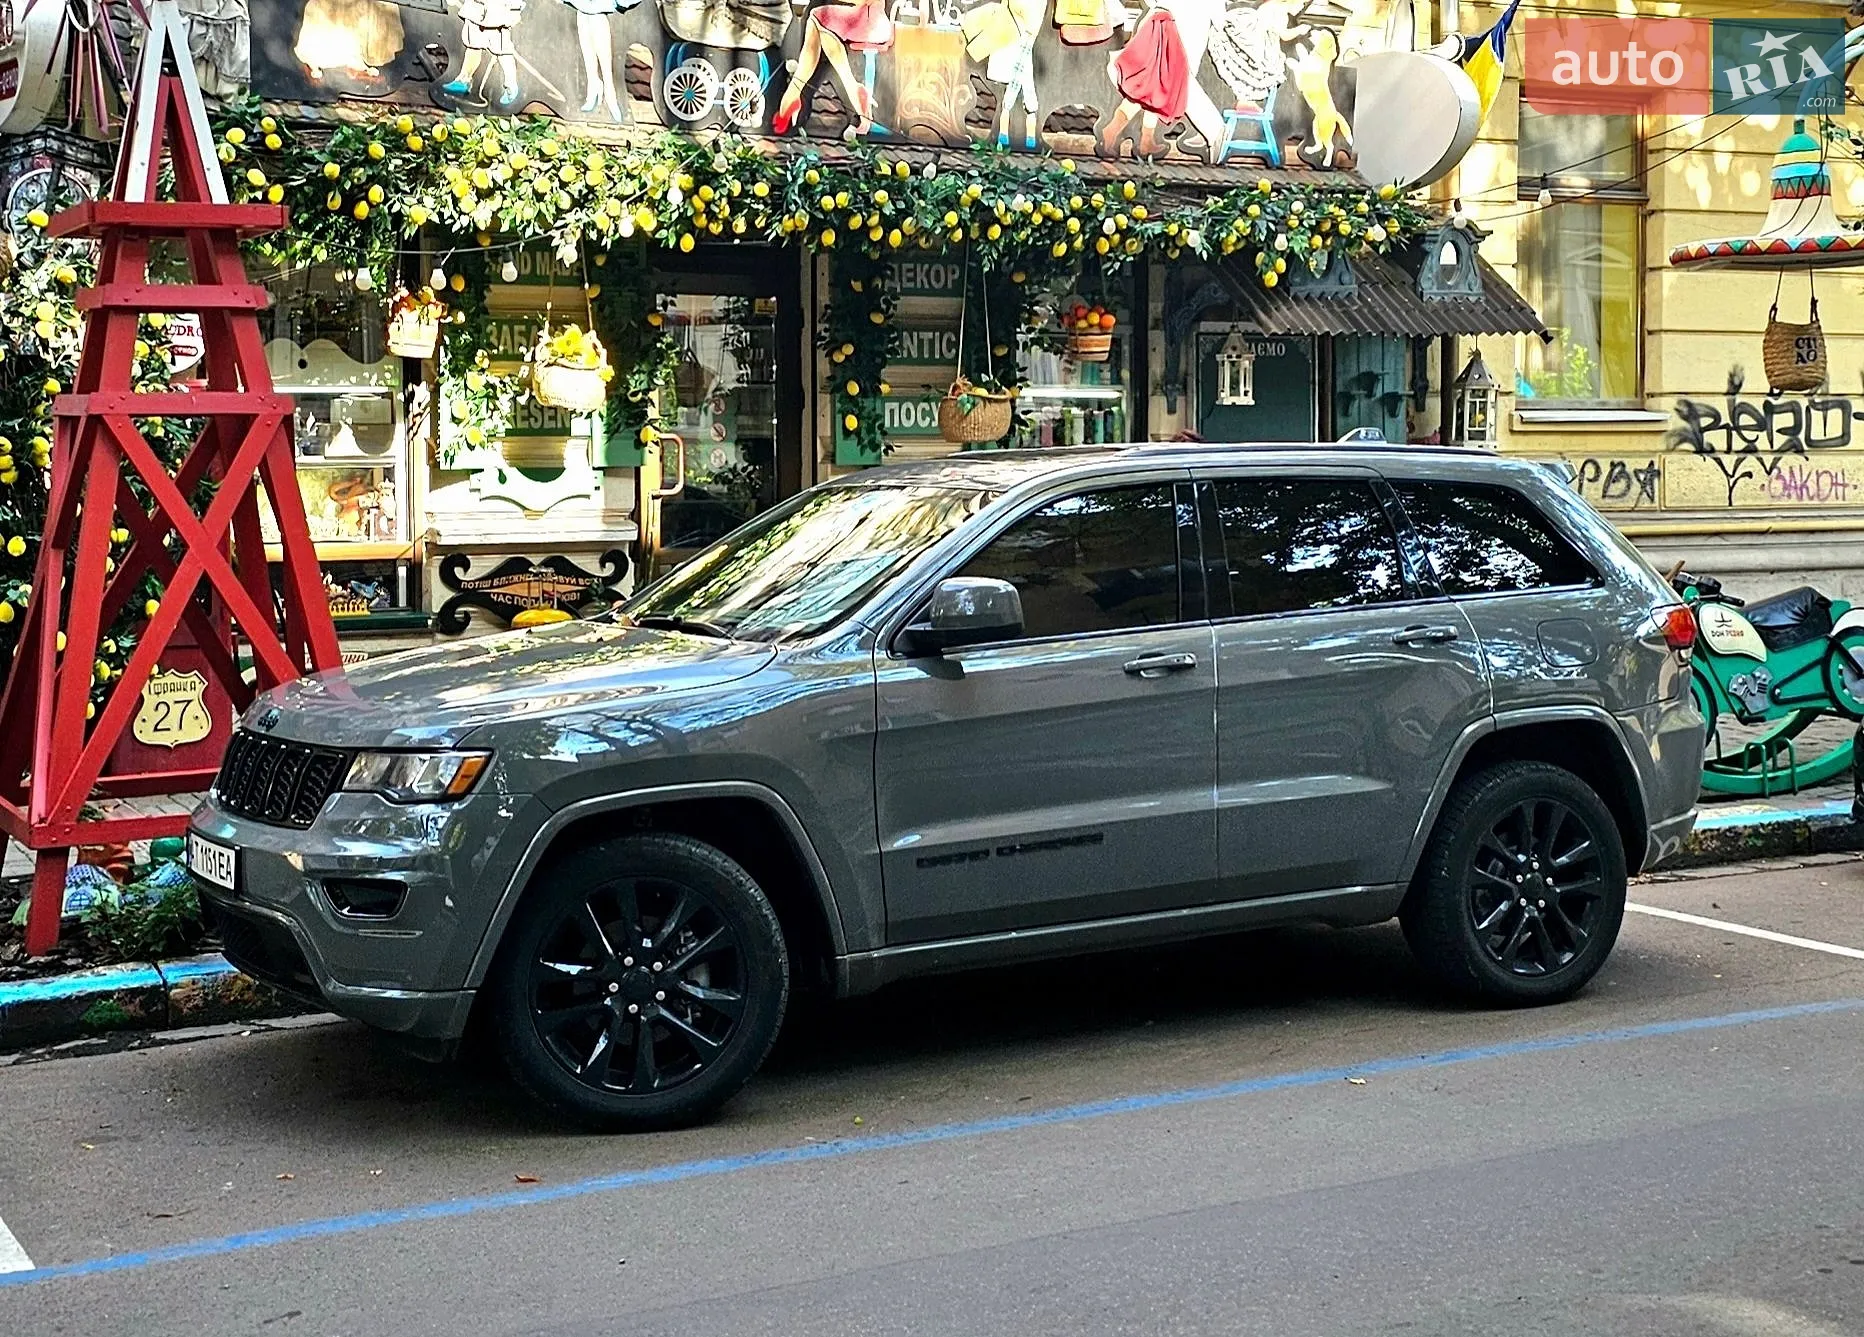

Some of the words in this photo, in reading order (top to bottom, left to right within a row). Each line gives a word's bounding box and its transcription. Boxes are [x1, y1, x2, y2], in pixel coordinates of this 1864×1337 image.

[885, 262, 960, 291] ДЕКОР
[888, 331, 956, 359] NTIC
[884, 402, 942, 428] ПОСУ
[153, 699, 194, 732] 27
